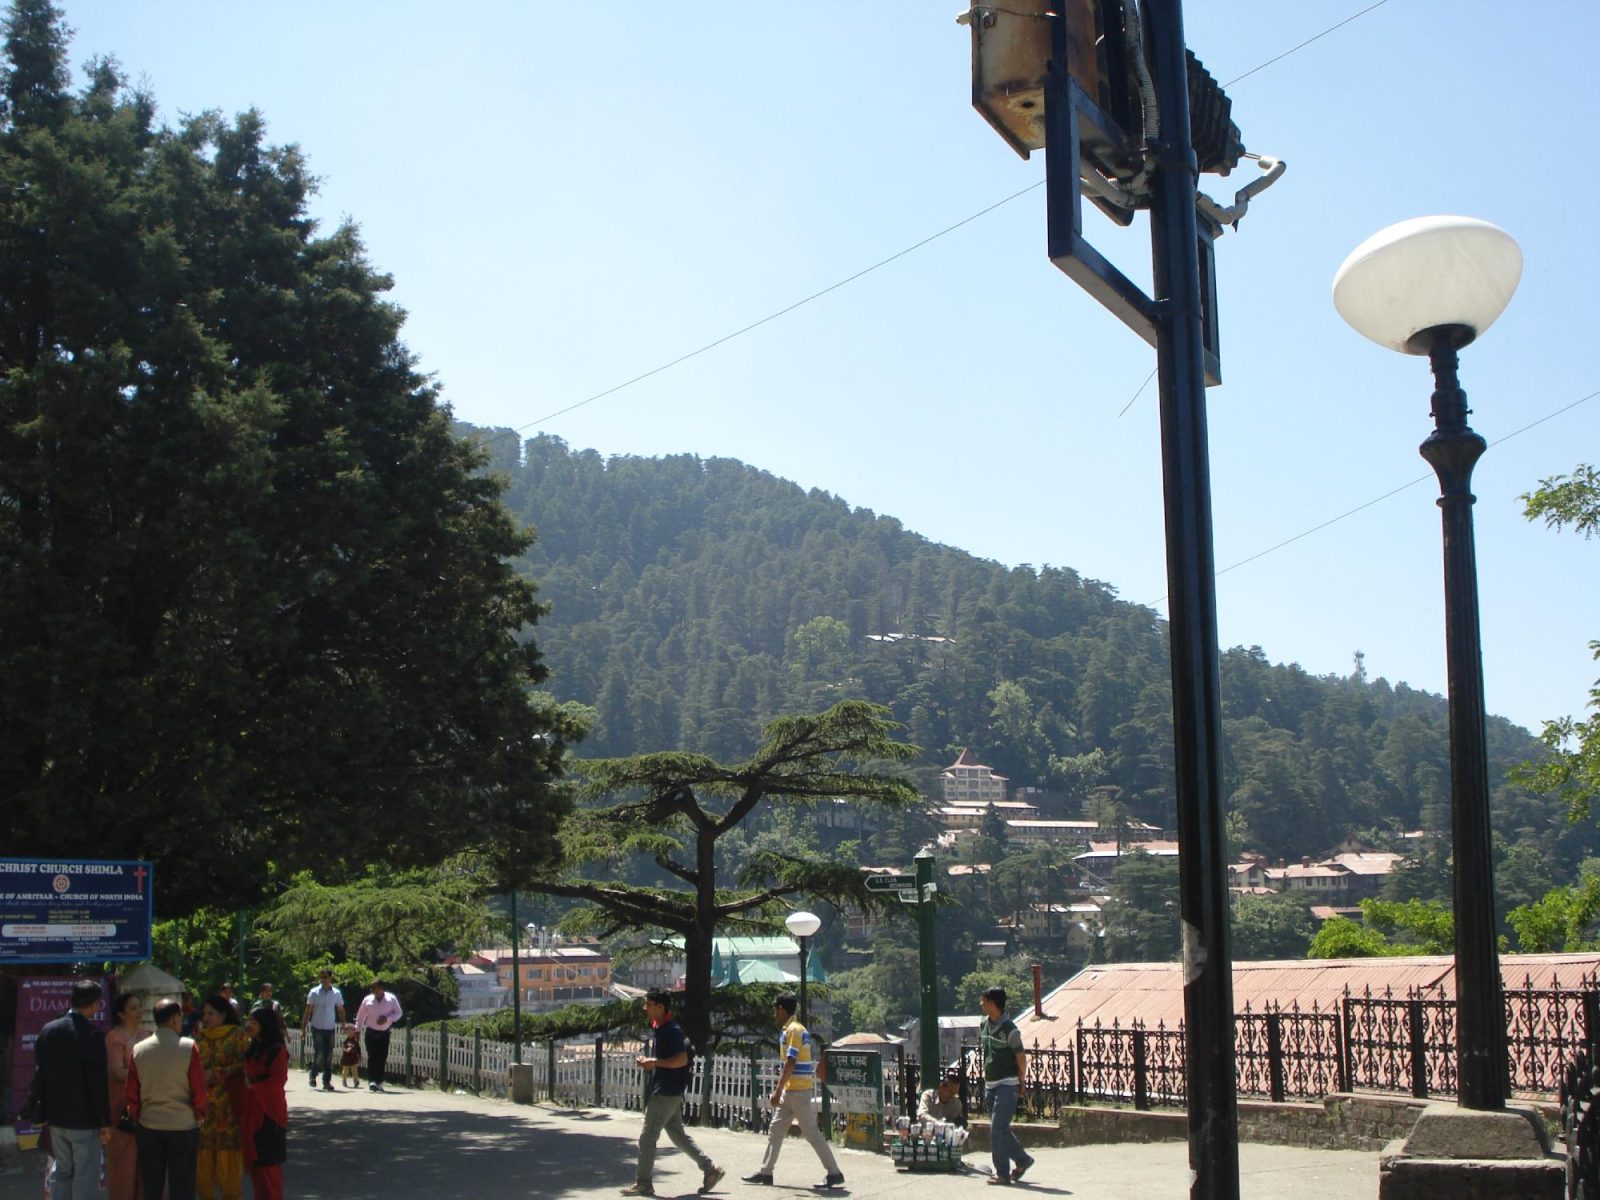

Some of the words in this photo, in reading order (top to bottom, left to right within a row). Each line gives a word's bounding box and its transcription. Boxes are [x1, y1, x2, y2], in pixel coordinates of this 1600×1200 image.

[0, 863, 38, 873] CHRIST
[39, 864, 83, 874] CHURCH
[84, 865, 123, 875] SHIMLA
